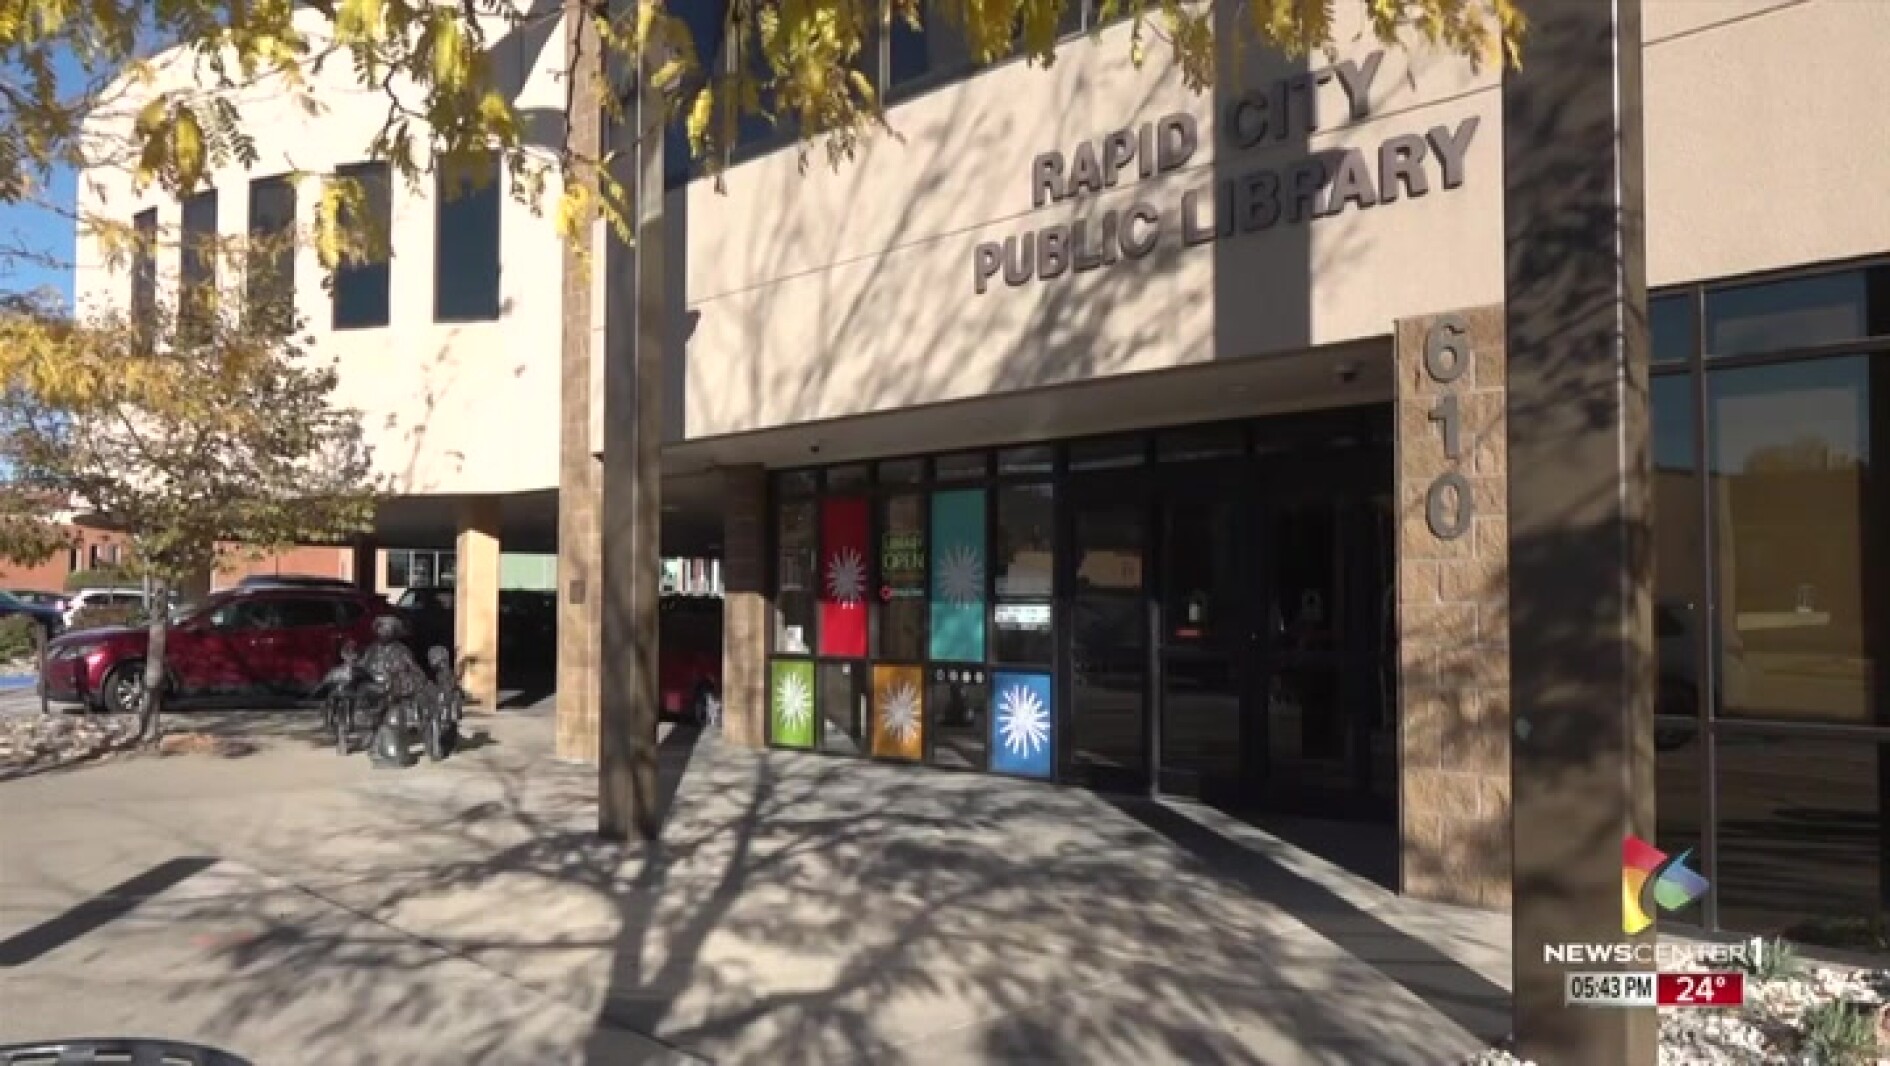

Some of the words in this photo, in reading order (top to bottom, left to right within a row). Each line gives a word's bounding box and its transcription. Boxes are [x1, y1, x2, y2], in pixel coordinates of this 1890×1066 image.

[974, 204, 1158, 294] PUBLIC
[1181, 116, 1481, 247] LIBRARY
[1032, 112, 1198, 207] RAPID
[1227, 50, 1383, 150] CITY
[1423, 313, 1472, 541] 610
